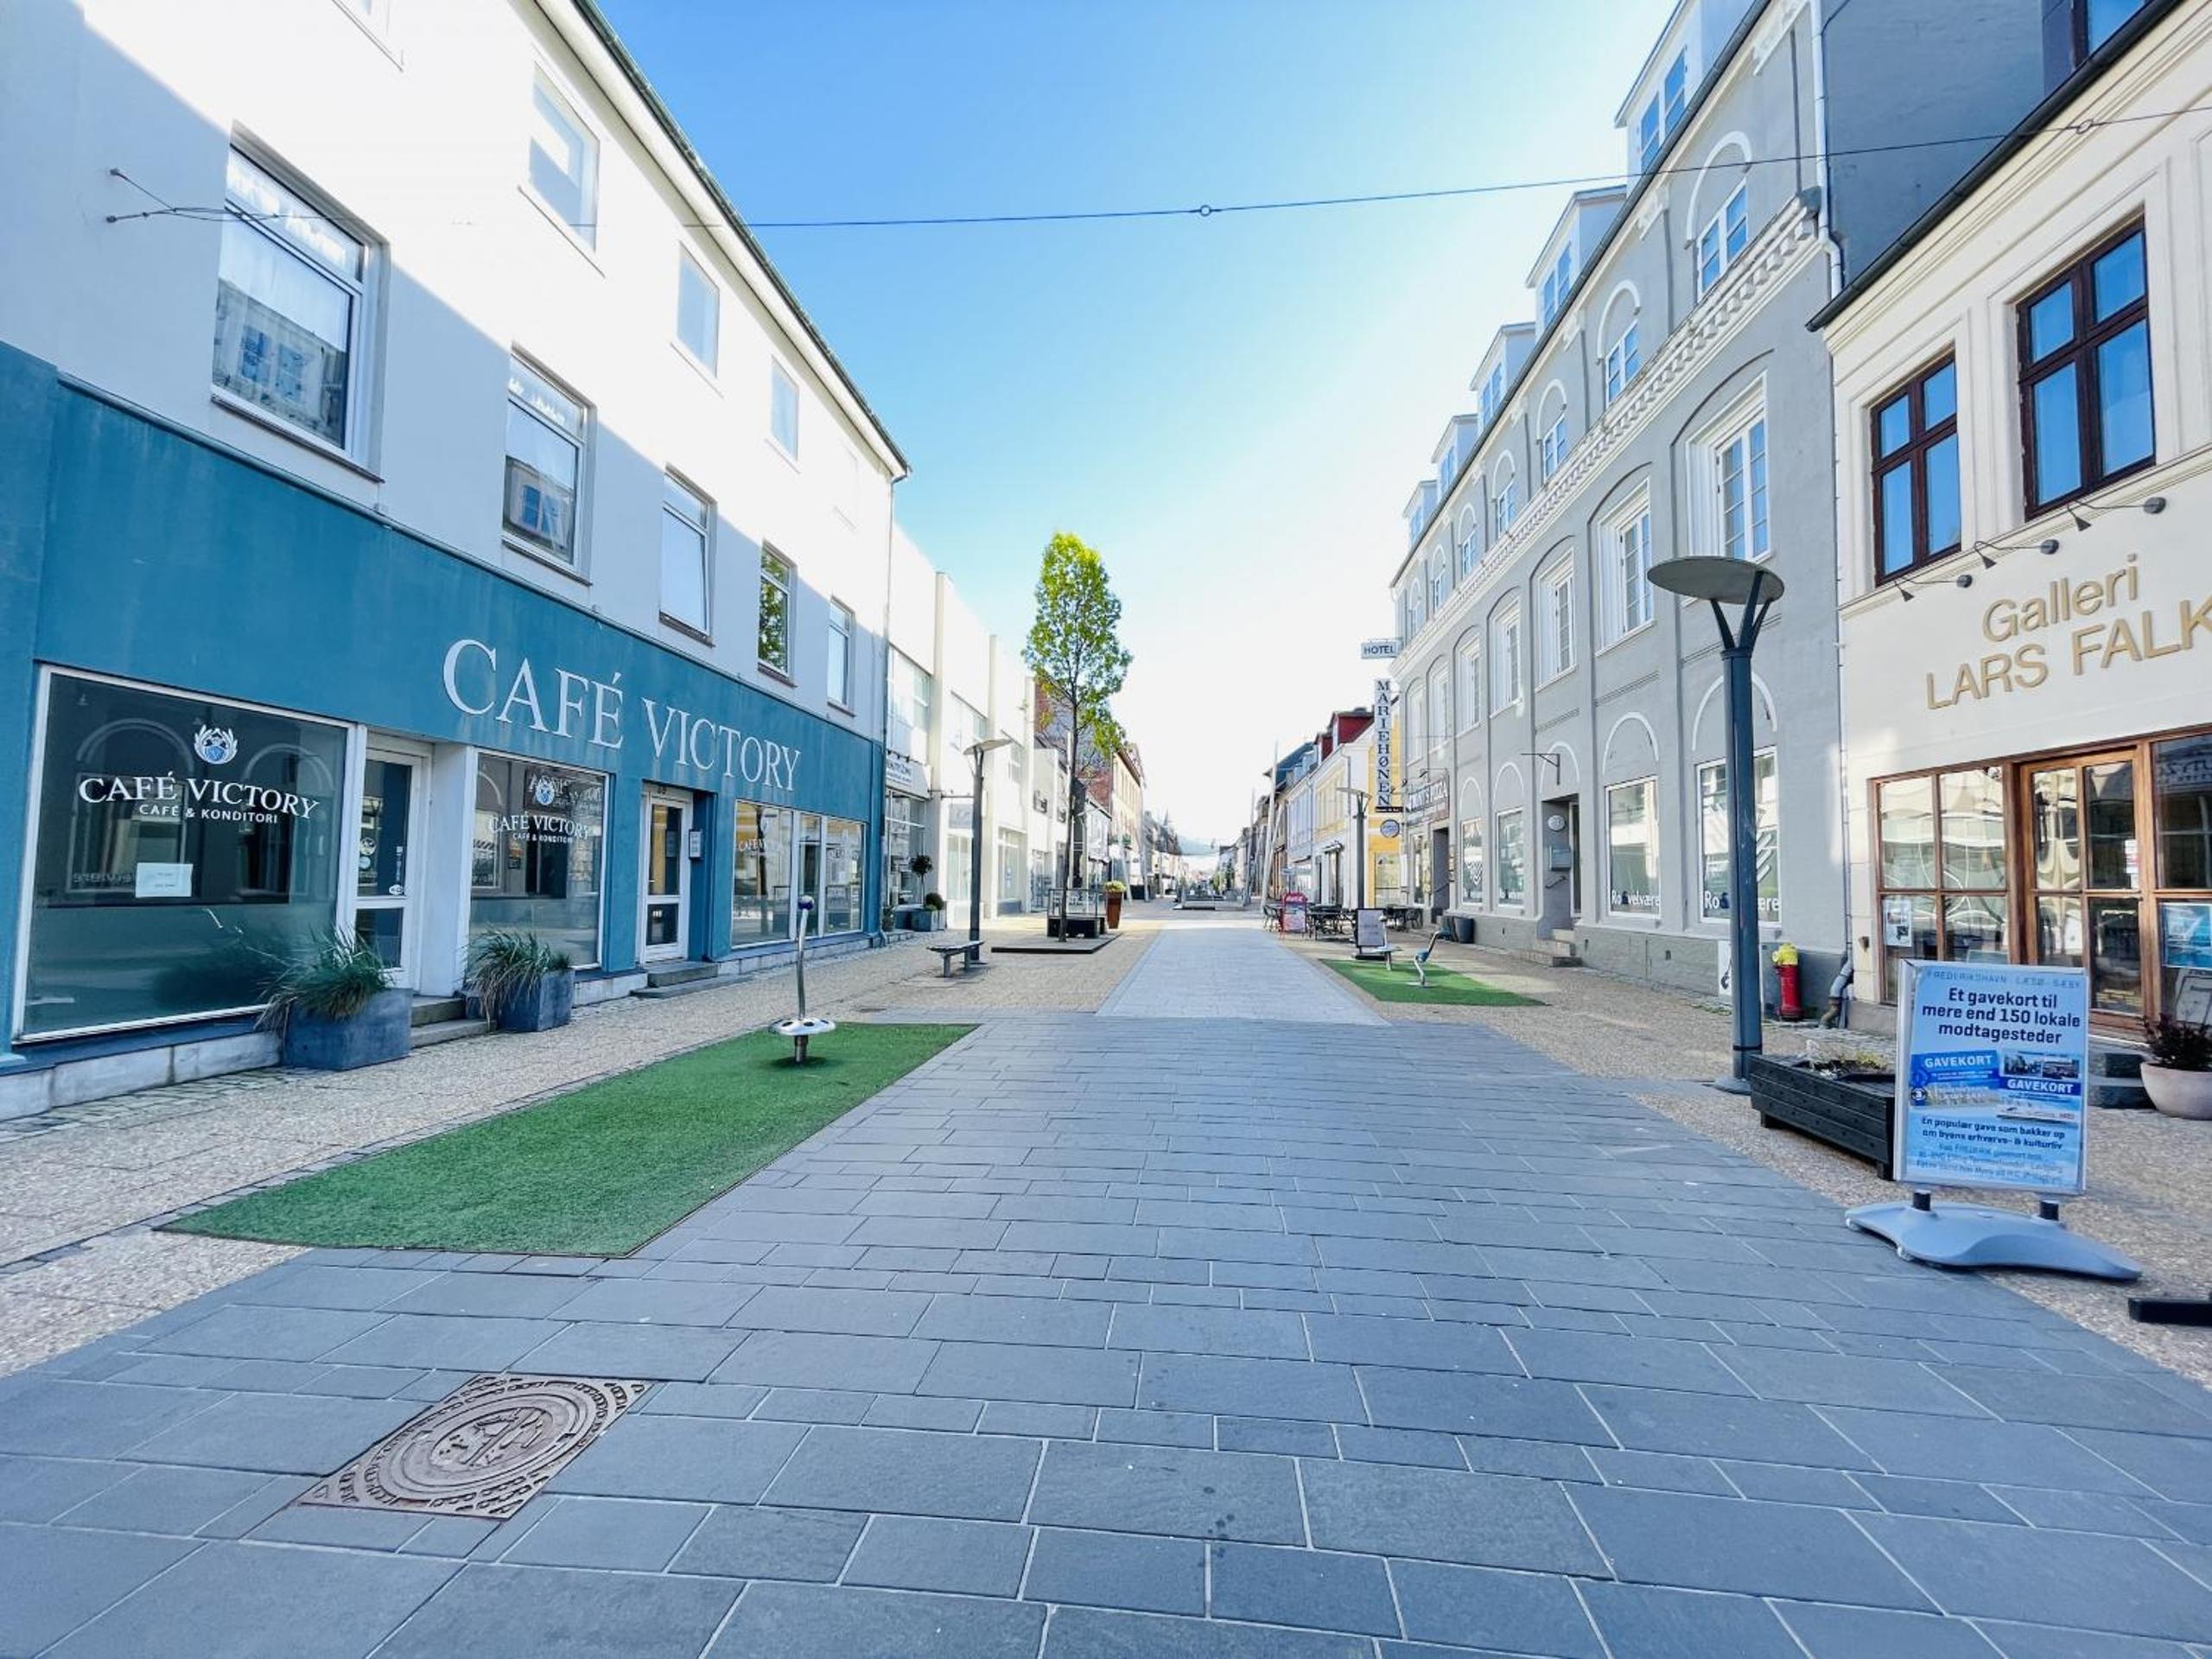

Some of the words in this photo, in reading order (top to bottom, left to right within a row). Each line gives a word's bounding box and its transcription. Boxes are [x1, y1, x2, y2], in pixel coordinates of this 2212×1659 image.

[1982, 552, 2139, 643] Galleri
[1363, 645, 1396, 655] HOTEL
[1925, 643, 2049, 709] LARS
[2072, 593, 2212, 676] FALK
[442, 639, 624, 749] CAFÉ
[641, 697, 802, 791] VICTORY
[1377, 680, 1390, 806] MARIEHØNEN
[79, 771, 177, 803] CAFÉ
[187, 778, 321, 819] VICTORY
[139, 803, 180, 817] CAFÉ
[186, 807, 195, 818] &
[201, 809, 278, 824] KONDITORI
[488, 810, 530, 834] CAFÉ
[533, 815, 588, 840] VICTORY
[1704, 891, 1720, 909] Ro
[1948, 988, 1965, 1001] Et
[1968, 991, 2038, 1007] gavekort
[2042, 995, 2057, 1008] til
[1922, 1006, 1962, 1019] mere
[1967, 1007, 1995, 1021] end
[2000, 1008, 2031, 1024] 150
[2034, 1011, 2081, 1027] lokale
[1938, 1023, 2063, 1044] modtagesteder
[1924, 1055, 1993, 1068] GAVEKORT
[2007, 1079, 2074, 1093] GAVEKORT
[1998, 1124, 2018, 1134] som
